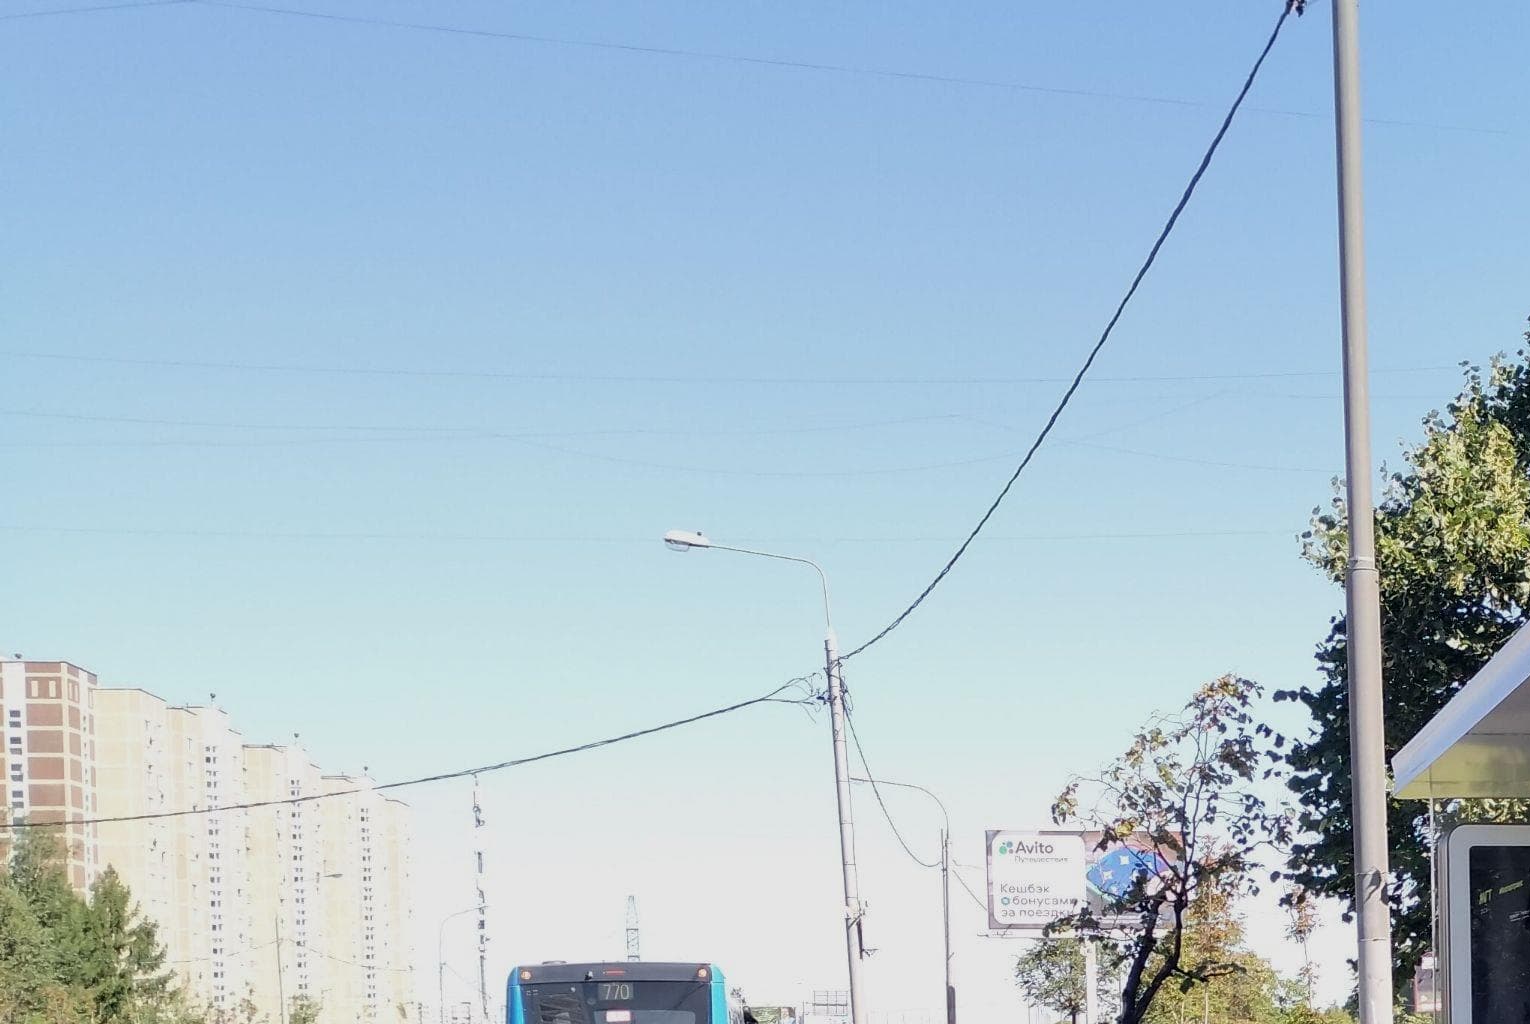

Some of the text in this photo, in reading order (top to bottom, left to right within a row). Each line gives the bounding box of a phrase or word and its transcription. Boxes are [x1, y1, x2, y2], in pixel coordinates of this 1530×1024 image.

[1015, 840, 1054, 855] Avito
[1000, 883, 1050, 894] Кешбэк
[1001, 909, 1016, 918] за
[603, 984, 630, 1000] 770
